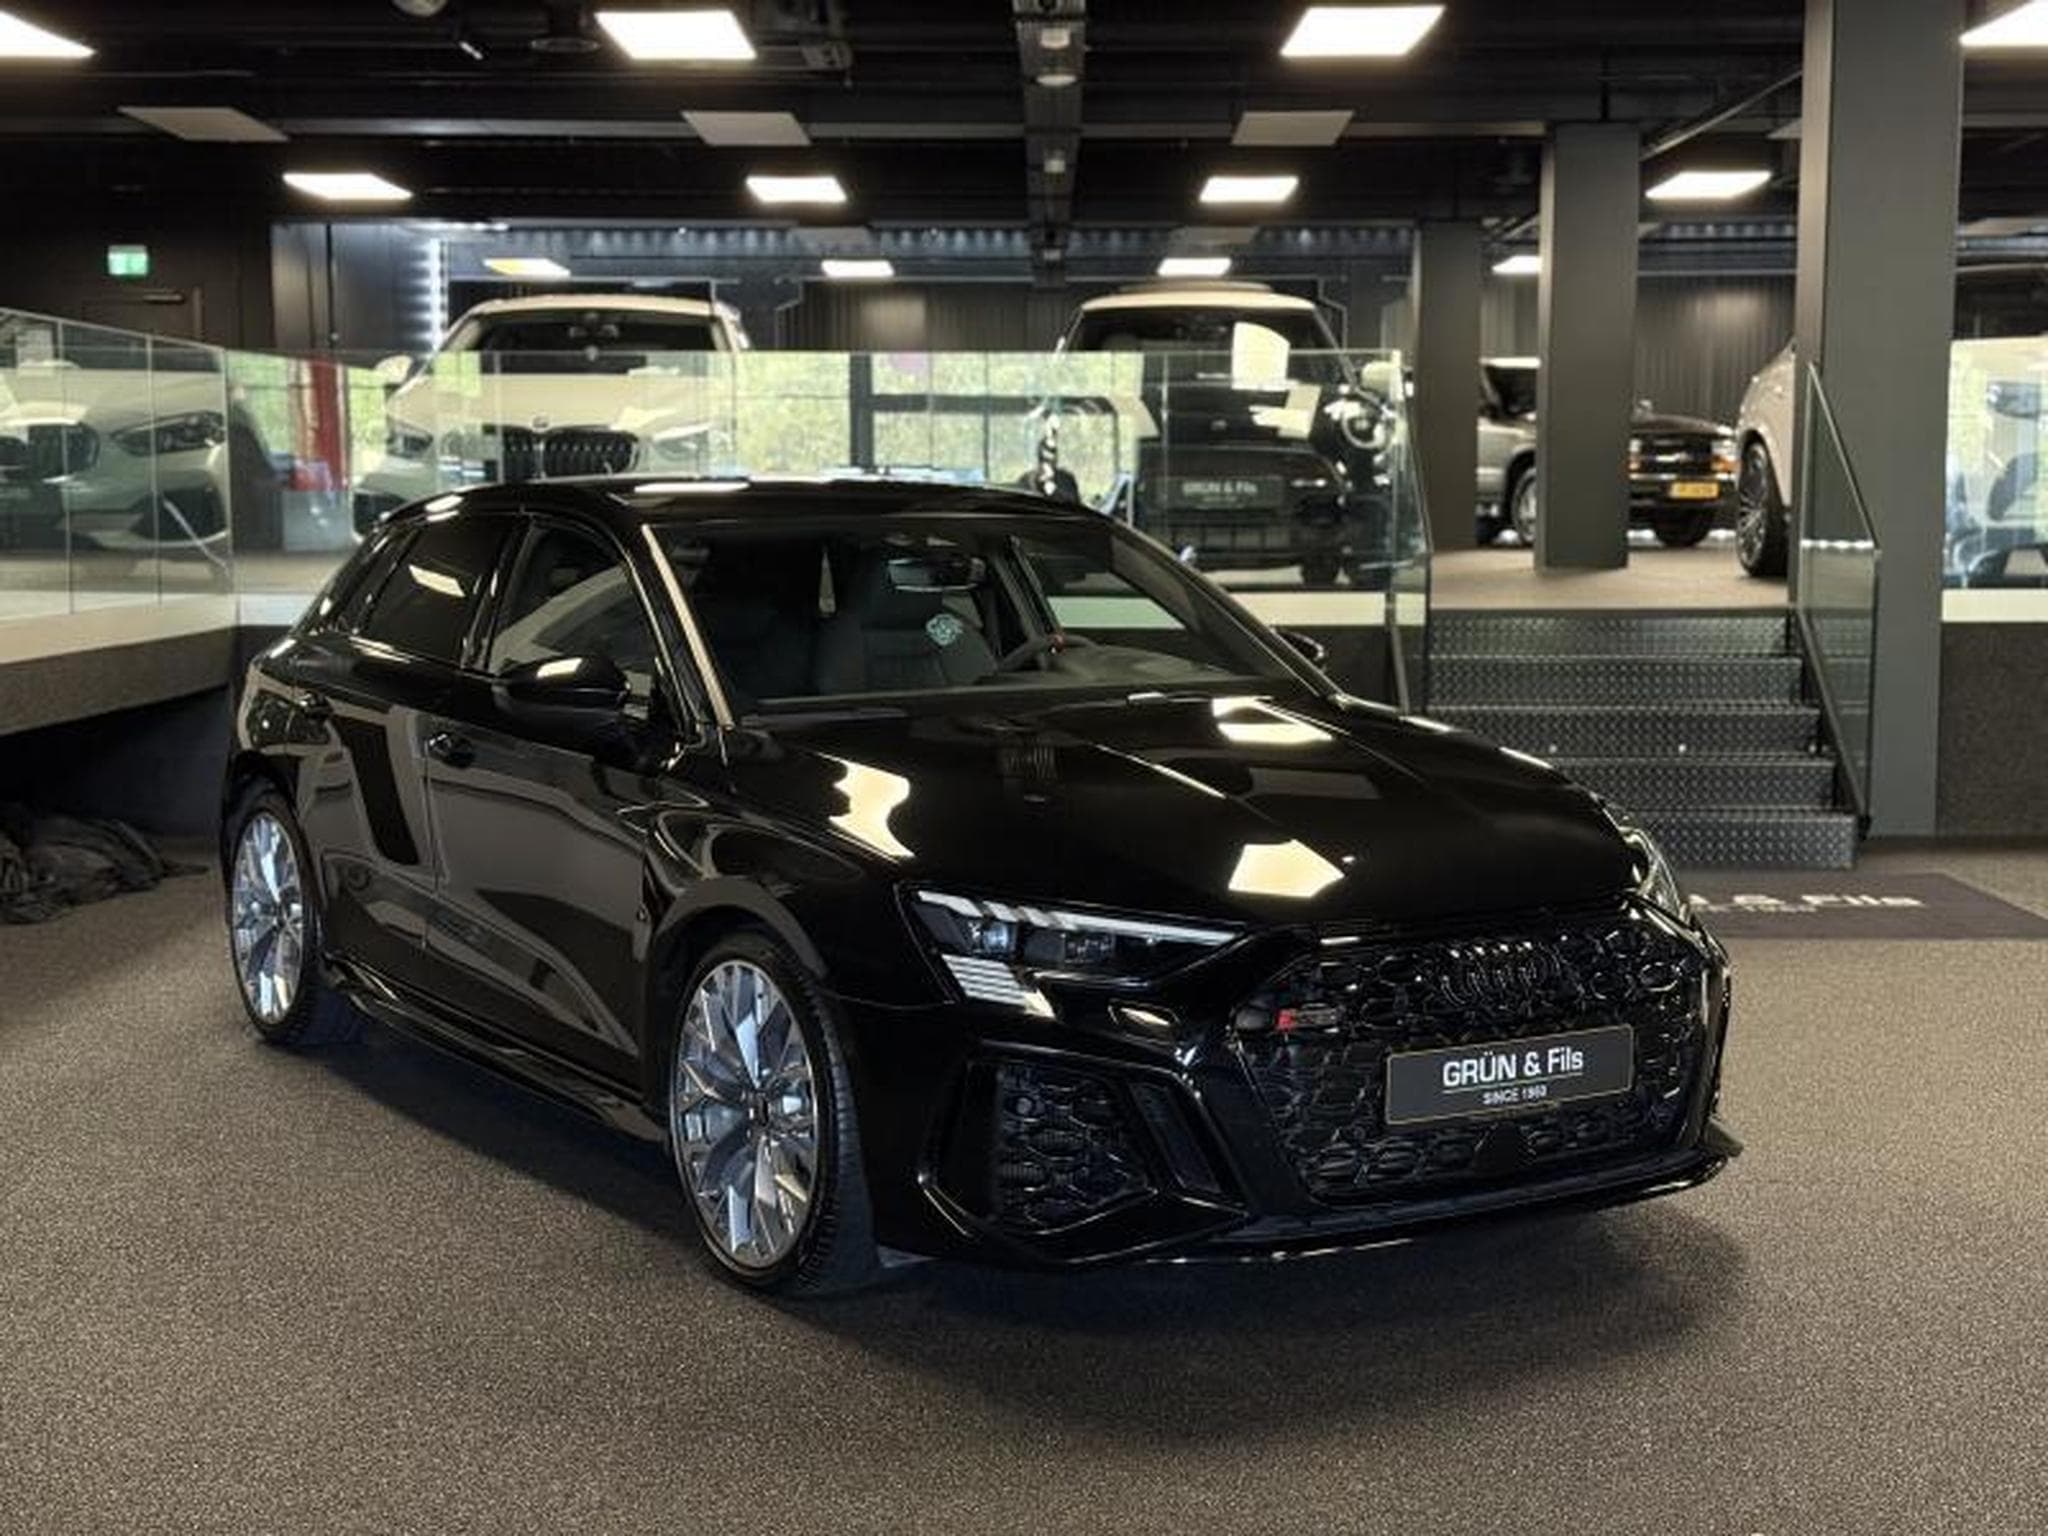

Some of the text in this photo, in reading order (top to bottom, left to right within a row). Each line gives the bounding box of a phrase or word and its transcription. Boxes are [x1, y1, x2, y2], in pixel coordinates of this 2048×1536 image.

[1442, 1046, 1584, 1087] GRÜN & Fils
[1482, 1087, 1519, 1105] SINCE
